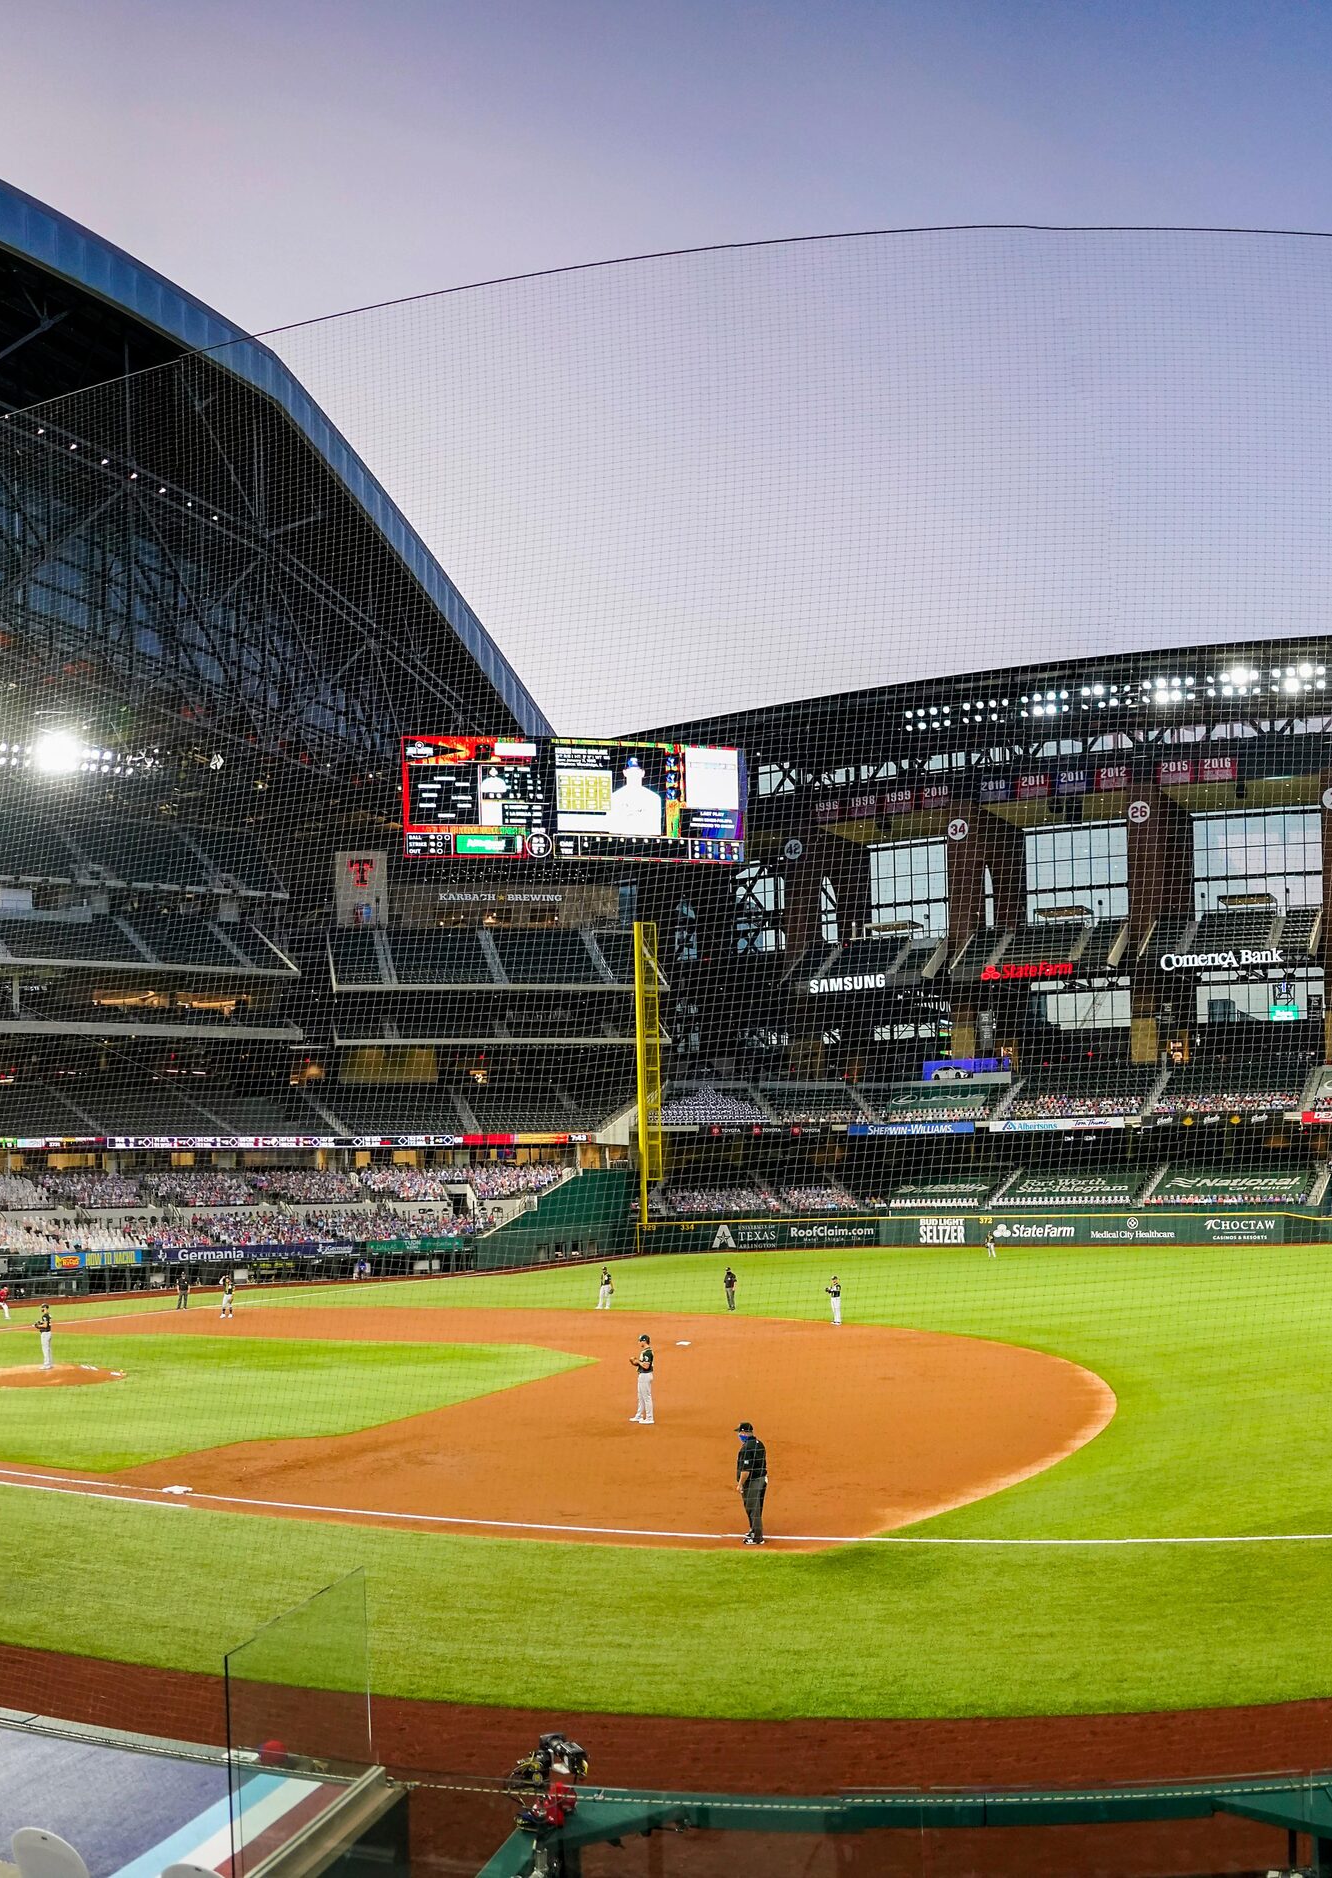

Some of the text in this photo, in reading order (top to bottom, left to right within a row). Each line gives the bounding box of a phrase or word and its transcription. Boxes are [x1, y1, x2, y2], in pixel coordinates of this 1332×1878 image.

[1162, 760, 1188, 773] 2015
[1204, 757, 1231, 769] 2016
[1060, 771, 1084, 783] 2011
[1100, 766, 1127, 779] 2012
[1021, 774, 1045, 787] 2011
[886, 791, 911, 802] 1999
[924, 785, 949, 798] 2010
[1131, 806, 1147, 818] 26
[950, 823, 965, 835] 34
[507, 894, 562, 902] BREWING
[1240, 947, 1284, 965] Bank
[809, 974, 886, 994] SAMSUNG
[1017, 1122, 1058, 1130] Albertsons
[1059, 1178, 1107, 1186] Worth
[680, 1223, 695, 1231] 334
[1213, 1220, 1275, 1230] CHOCTAW
[738, 1231, 776, 1241] TEXAS
[790, 1225, 874, 1239] RoofClaim.com
[919, 1226, 965, 1243] SELTZER
[1091, 1230, 1175, 1240] Medical City Healthcare
[739, 1242, 776, 1250] ARLINGTON
[86, 1253, 100, 1265] HOW
[178, 1247, 245, 1261] Germania
